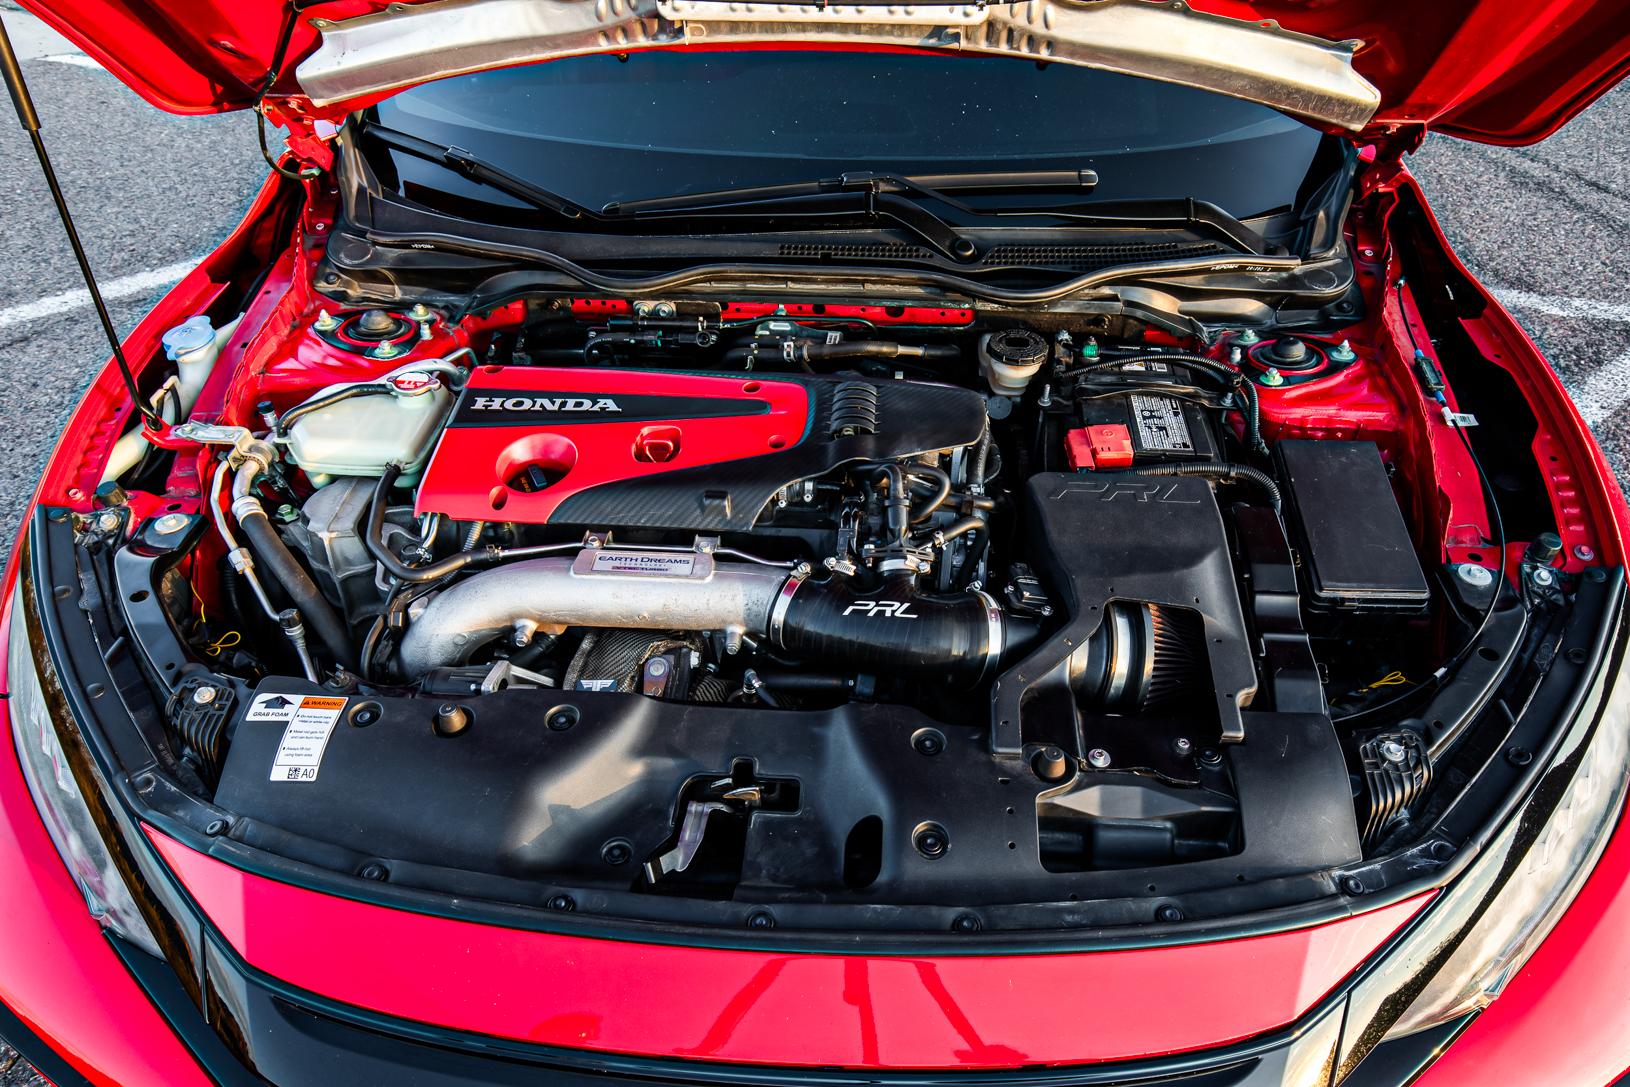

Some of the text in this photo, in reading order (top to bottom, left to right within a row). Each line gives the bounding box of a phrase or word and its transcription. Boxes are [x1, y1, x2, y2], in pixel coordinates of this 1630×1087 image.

[470, 397, 622, 412] HONDA
[1048, 481, 1201, 503] PRL
[640, 556, 690, 565] DREAMS
[842, 600, 918, 618] PRL
[301, 768, 315, 779] A0
